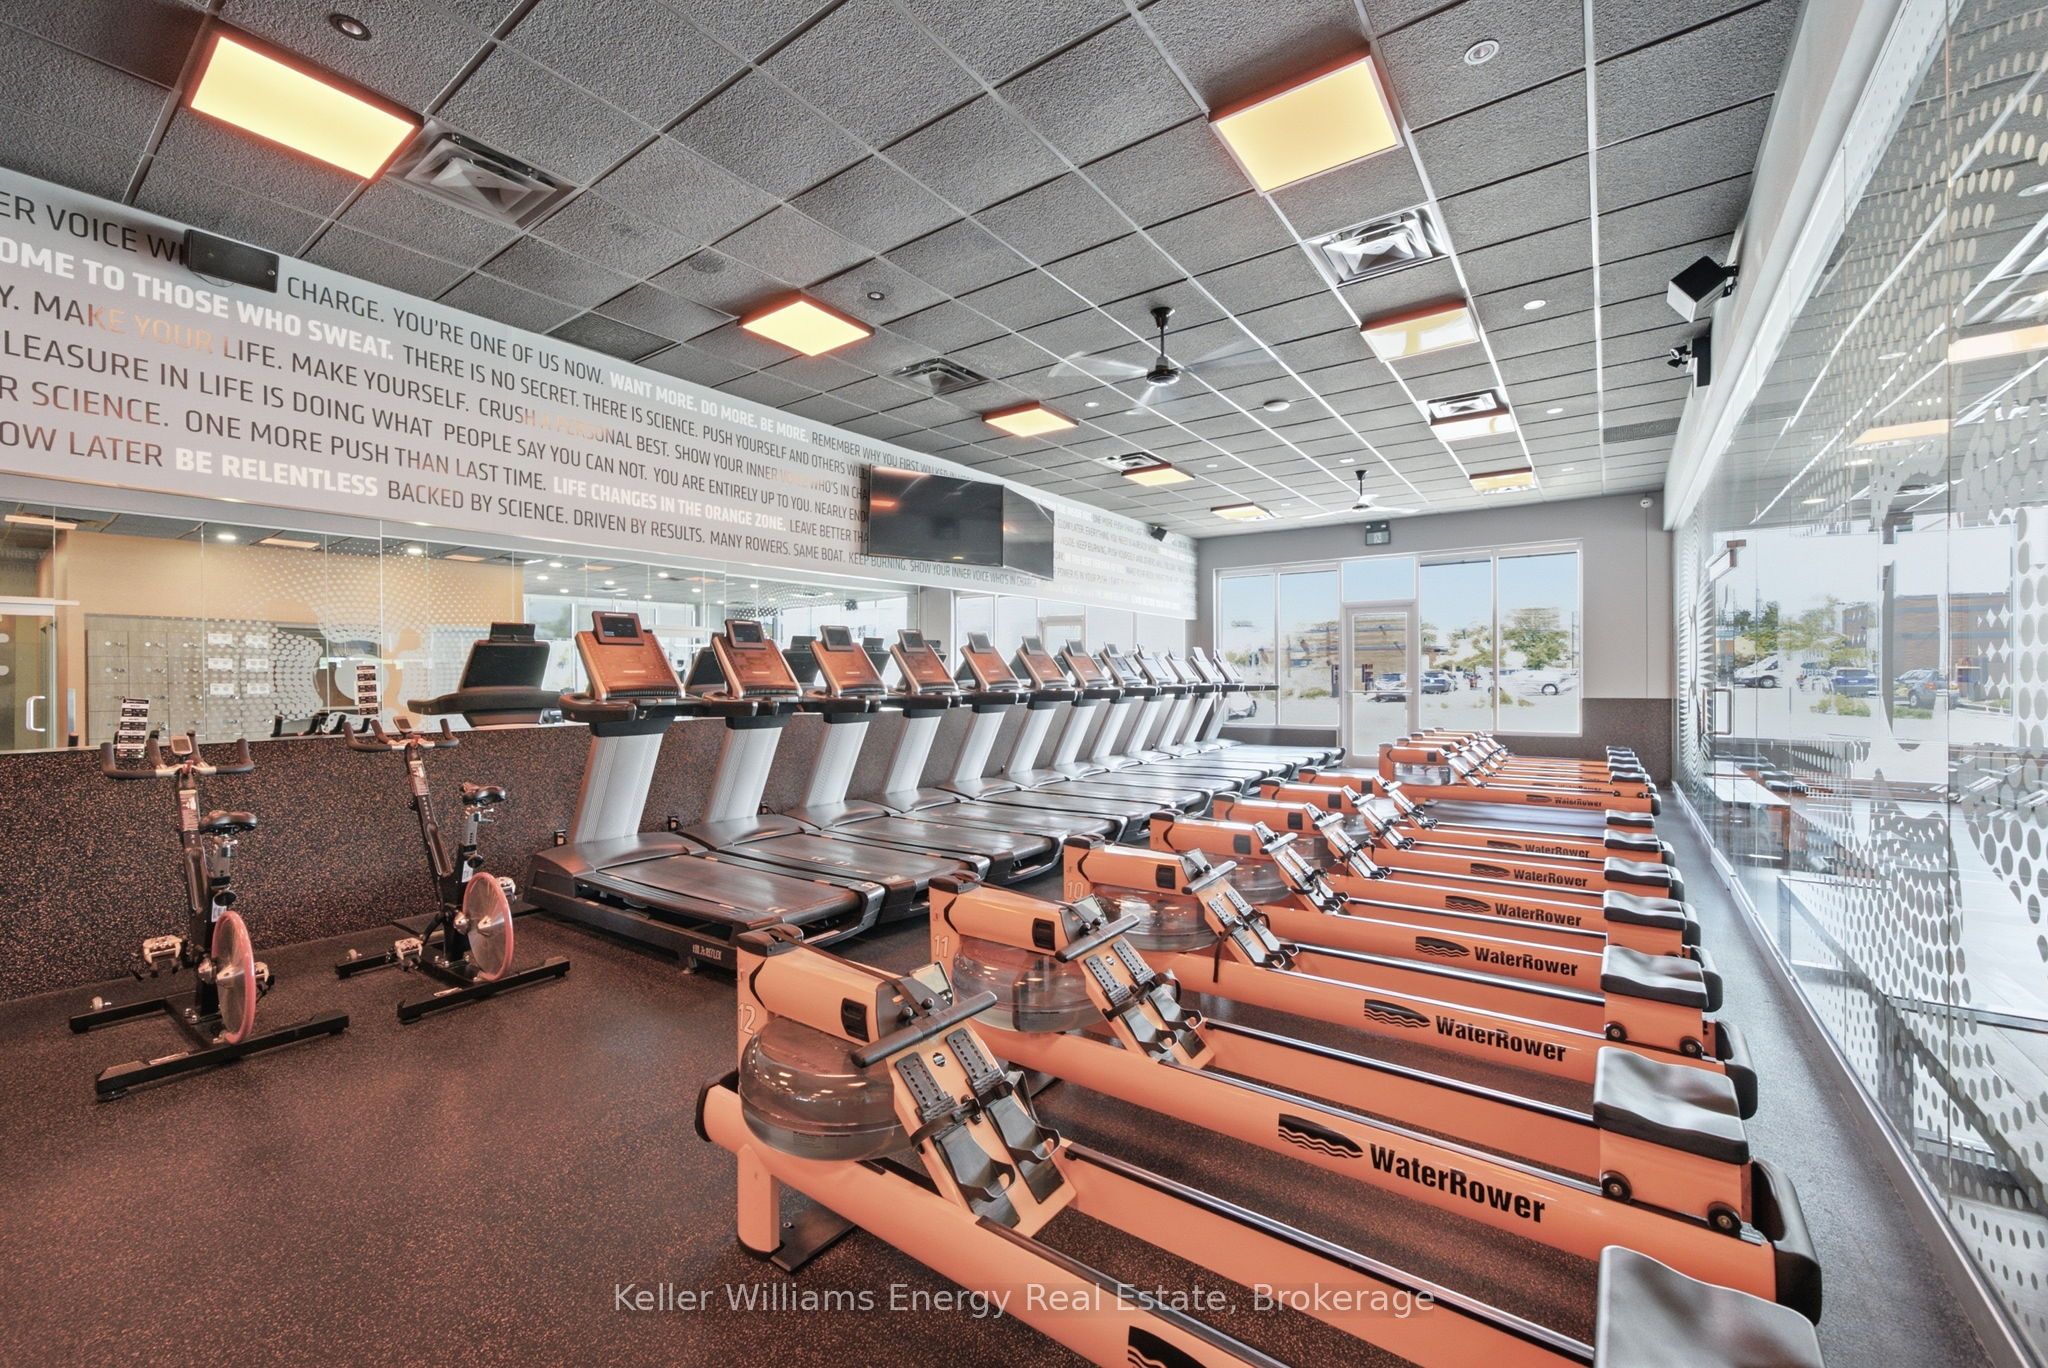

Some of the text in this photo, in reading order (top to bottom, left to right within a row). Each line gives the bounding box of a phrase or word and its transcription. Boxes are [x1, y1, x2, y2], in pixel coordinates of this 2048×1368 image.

[47, 205, 137, 252] VOICE
[83, 258, 125, 291] TO
[133, 271, 229, 319] THOSE
[236, 300, 300, 337] WHO
[308, 319, 394, 360] SWEAT.
[402, 345, 464, 378] THERE
[471, 364, 485, 383] IS
[492, 370, 515, 391] NO
[521, 377, 579, 407] SECRET.
[582, 393, 627, 420] THERE
[631, 406, 643, 423] IS
[647, 410, 698, 437] SCIENCE.
[703, 425, 733, 446] PUSH
[736, 434, 787, 459] YOURSELF
[789, 448, 809, 465] AND
[812, 455, 845, 474] OTHERS
[847, 463, 866, 479] WILL
[287, 276, 384, 322] CHARGE.
[394, 307, 463, 345] YOU'RE
[470, 331, 506, 357] ONE
[512, 344, 533, 363] OF
[539, 351, 559, 372] US
[564, 358, 603, 385] NOW.
[610, 372, 652, 400] WANT
[656, 385, 697, 412] MORE.
[701, 398, 717, 417] DO
[721, 404, 757, 429] MORE.
[760, 418, 774, 433] BE
[776, 422, 809, 443] MORE.
[812, 432, 860, 456] REMEMBER
[863, 447, 880, 460] WHY
[883, 452, 898, 466] YOU
[900, 457, 919, 472] FIRST
[34, 291, 127, 334] MAKE
[134, 313, 214, 354] YOUR
[224, 336, 282, 370] LIFE.
[292, 352, 357, 387] MAKE
[364, 369, 469, 412] YOURSELF.
[479, 397, 536, 426] CRUSH
[637, 436, 670, 457] BEST.
[675, 445, 710, 466] SHOW
[714, 453, 743, 473] YOUR
[746, 462, 777, 481] INNER
[841, 484, 849, 497] IN
[851, 486, 867, 499] CHA
[4, 330, 149, 381] LEASURE
[160, 363, 189, 390] IN
[200, 371, 253, 403] LIFE
[264, 385, 284, 408] IS
[293, 391, 364, 425] DOING
[372, 407, 432, 438] WHAT
[444, 423, 512, 454] PEOPLE
[517, 438, 546, 460] SAY
[550, 445, 581, 468] YOU
[586, 453, 614, 475] CAN
[618, 458, 647, 481] NOT.
[653, 467, 678, 486] YOU
[682, 474, 705, 492] ARE
[709, 479, 757, 504] ENTIRELY
[760, 489, 774, 504] UP
[777, 493, 788, 508] TO
[791, 495, 812, 513] YOU.
[815, 501, 847, 519] NEARLY
[32, 381, 169, 428] SCIENCE.
[185, 409, 241, 439] ONE
[251, 421, 322, 453] MORE
[331, 435, 388, 464] PUSH
[394, 447, 449, 474] THAN
[456, 458, 498, 483] LAST
[503, 466, 546, 491] TIME.
[554, 476, 586, 498] LIFE
[591, 483, 657, 510] CHANGES
[661, 495, 674, 512] IN
[677, 498, 701, 518] THE
[705, 502, 752, 526] ORANGE
[755, 512, 786, 531] ZONE.
[790, 519, 817, 536] LEAVE
[820, 524, 851, 541] BETTER
[853, 530, 868, 544] THA
[69, 431, 163, 467] LATER
[175, 447, 212, 474] BE
[222, 454, 378, 497] RELENTLESS
[388, 480, 463, 509] BACKED
[471, 493, 492, 513] BY
[498, 498, 568, 524] SCIENCE.
[574, 509, 626, 533] DRIVEN
[631, 518, 647, 534] BY
[651, 521, 705, 544] RESULTS.
[710, 531, 742, 550] MANY
[745, 536, 790, 556] ROWERS.
[793, 543, 819, 559] SAME
[821, 547, 846, 563] BOAT.
[848, 552, 869, 566] KEEP
[871, 556, 908, 571] BURNING.
[910, 560, 931, 574] SHOW
[933, 564, 950, 576] YOUR
[952, 567, 971, 579] INNER
[1525, 844, 1590, 858] WaterRower
[1067, 881, 1084, 902] 10
[1513, 868, 1588, 888] WaterRower
[1494, 902, 1582, 927] WaterRower
[934, 935, 949, 958] 11
[1474, 945, 1579, 977] WaterRower
[738, 1002, 756, 1036] 12
[1436, 1015, 1567, 1062] WaterRower
[1369, 1142, 1547, 1224] WaterRower
